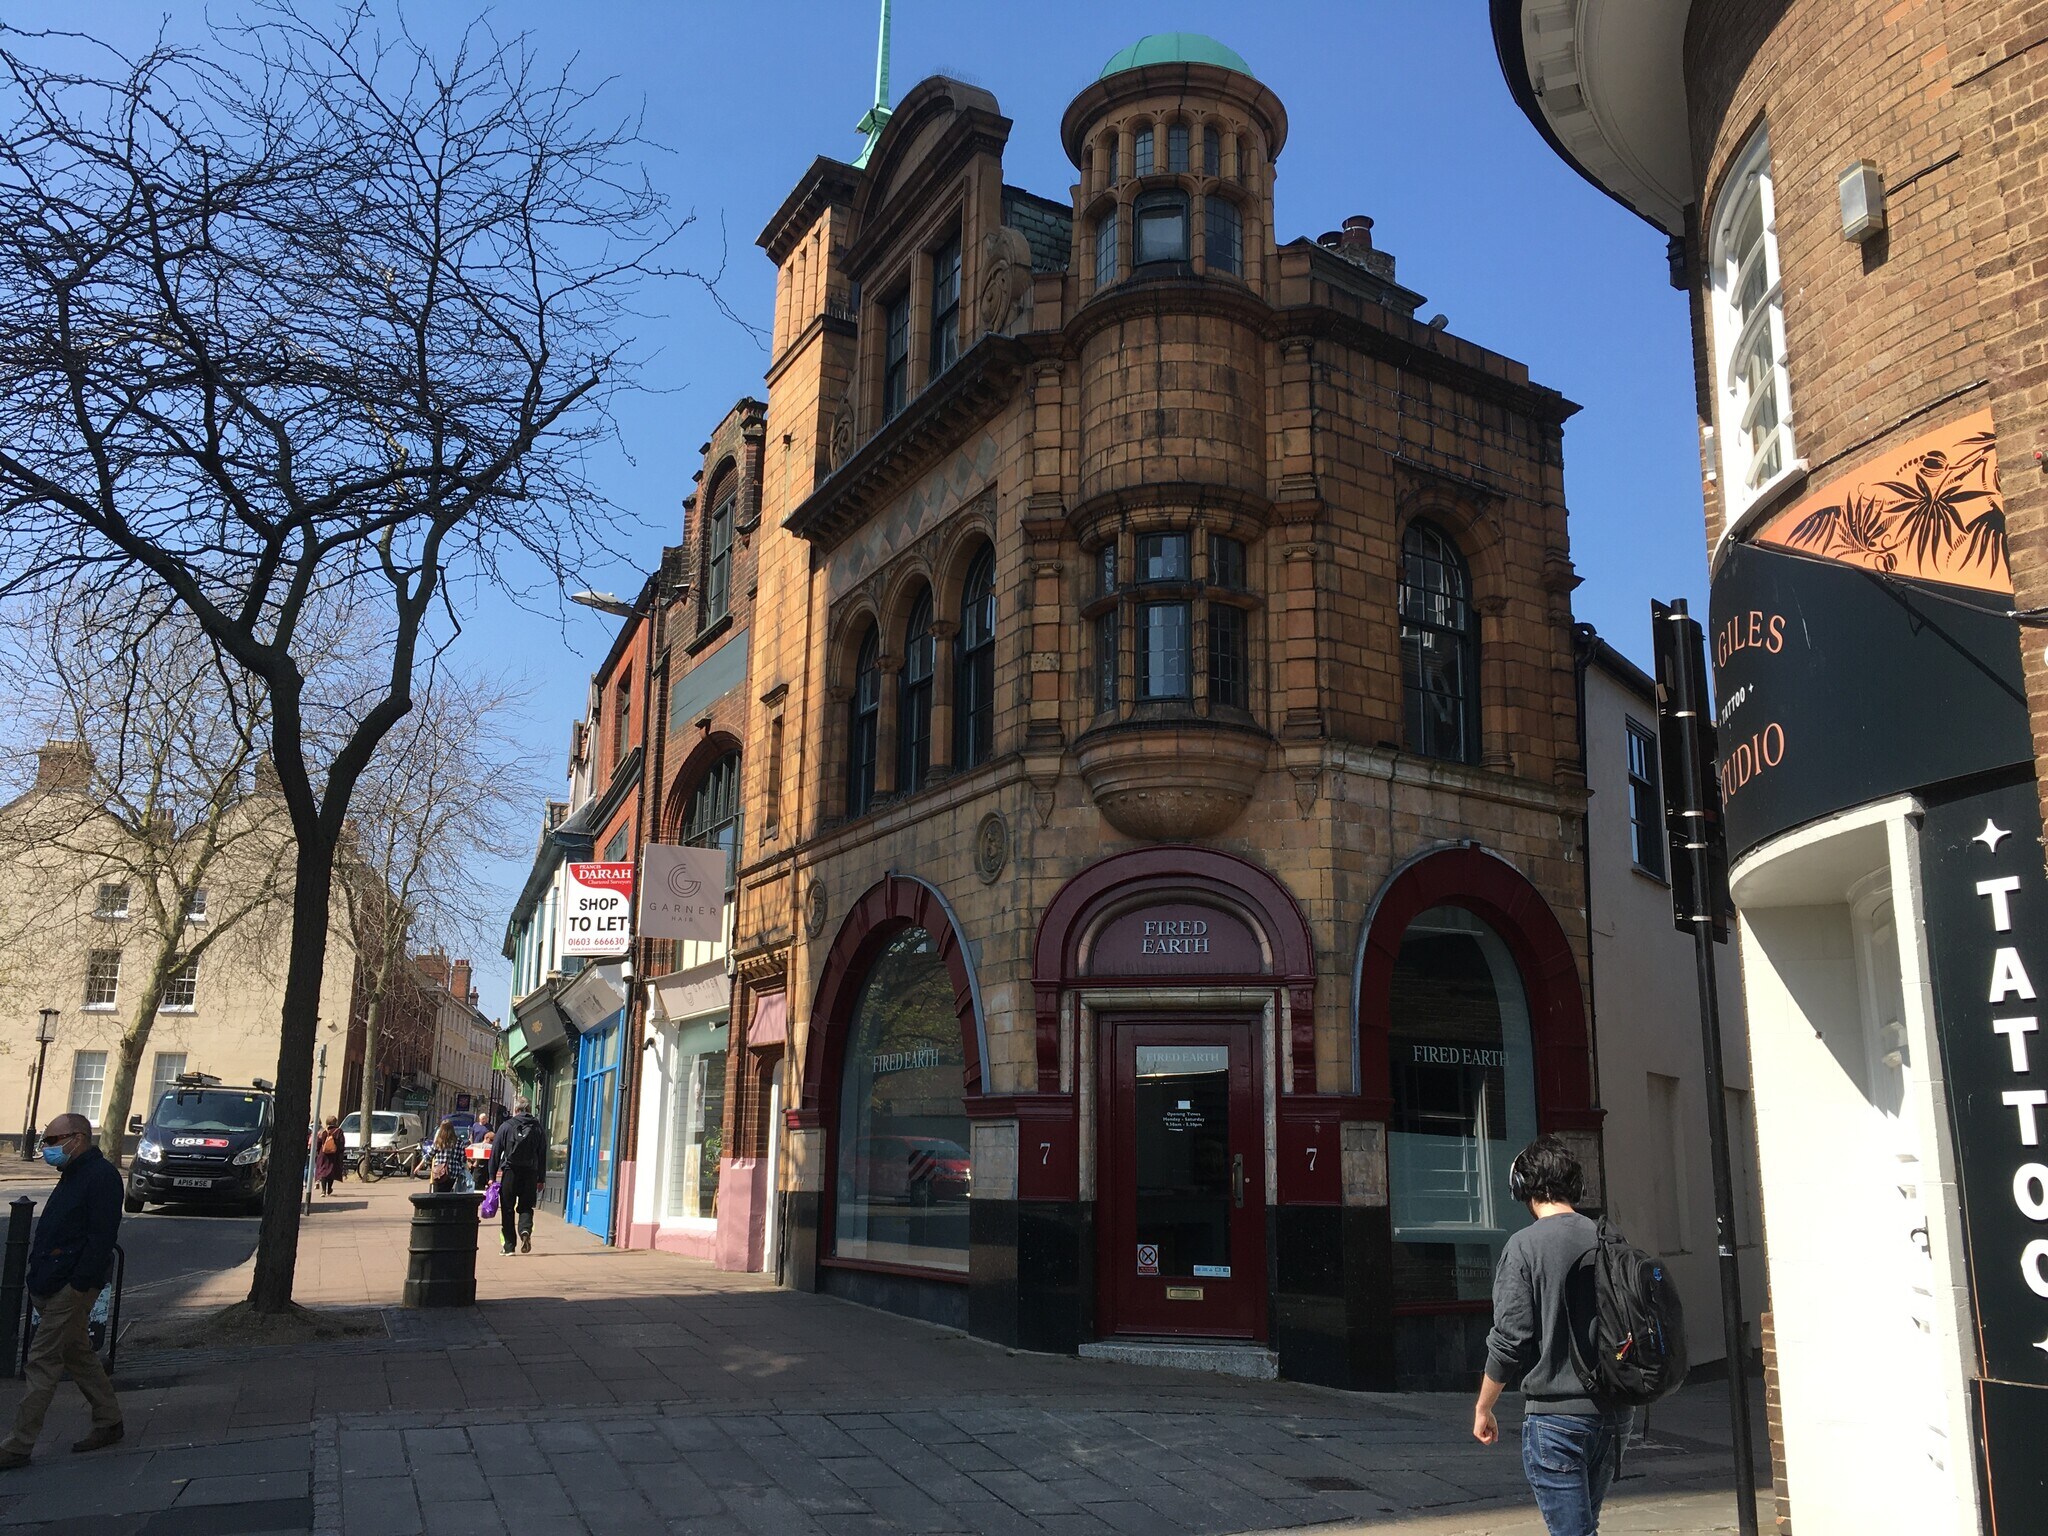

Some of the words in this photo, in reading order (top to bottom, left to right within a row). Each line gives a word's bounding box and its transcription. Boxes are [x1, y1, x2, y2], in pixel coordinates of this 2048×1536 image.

[1717, 610, 1786, 668] GILES
[1721, 686, 1746, 726] TATTOO
[578, 869, 632, 880] DARRAH
[579, 898, 619, 911] SHOP
[649, 902, 717, 916] GARNER
[569, 917, 591, 932] TO
[597, 916, 628, 931] LET
[1143, 920, 1208, 936] FIRED
[568, 938, 591, 946] 01603
[594, 937, 625, 946] 666630
[1141, 937, 1210, 954] EARTH
[873, 1053, 903, 1073] FIRED
[904, 1048, 940, 1069] EARTH
[1146, 1052, 1180, 1062] FIRED
[1182, 1052, 1220, 1062] EARTH
[1412, 1045, 1460, 1064] FIRED
[1462, 1048, 1510, 1067] EARTH
[1039, 1142, 1051, 1166] 7
[1305, 1147, 1318, 1171] 7
